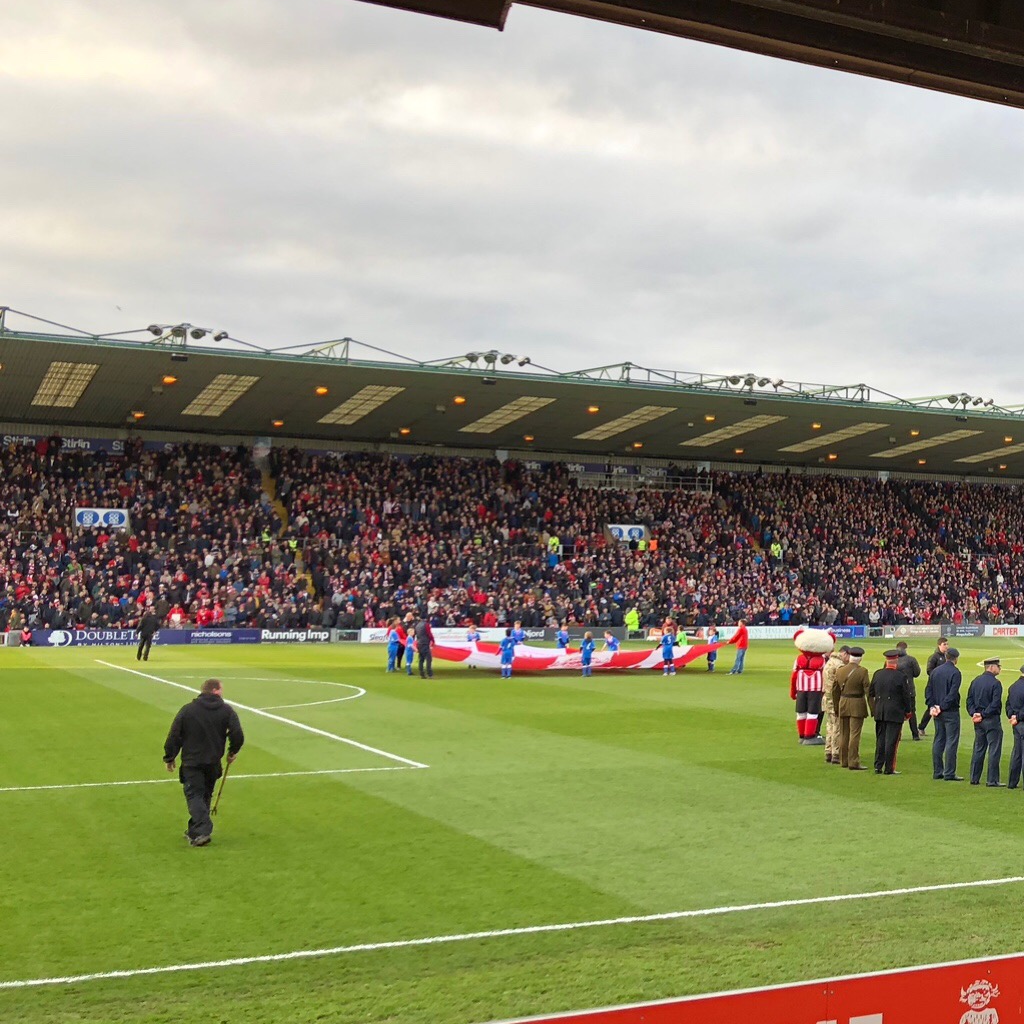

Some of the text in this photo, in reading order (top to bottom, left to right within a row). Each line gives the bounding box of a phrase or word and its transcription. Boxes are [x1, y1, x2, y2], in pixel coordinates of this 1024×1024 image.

[261, 628, 328, 642] Running Imp
[992, 628, 1018, 636] CARTER
